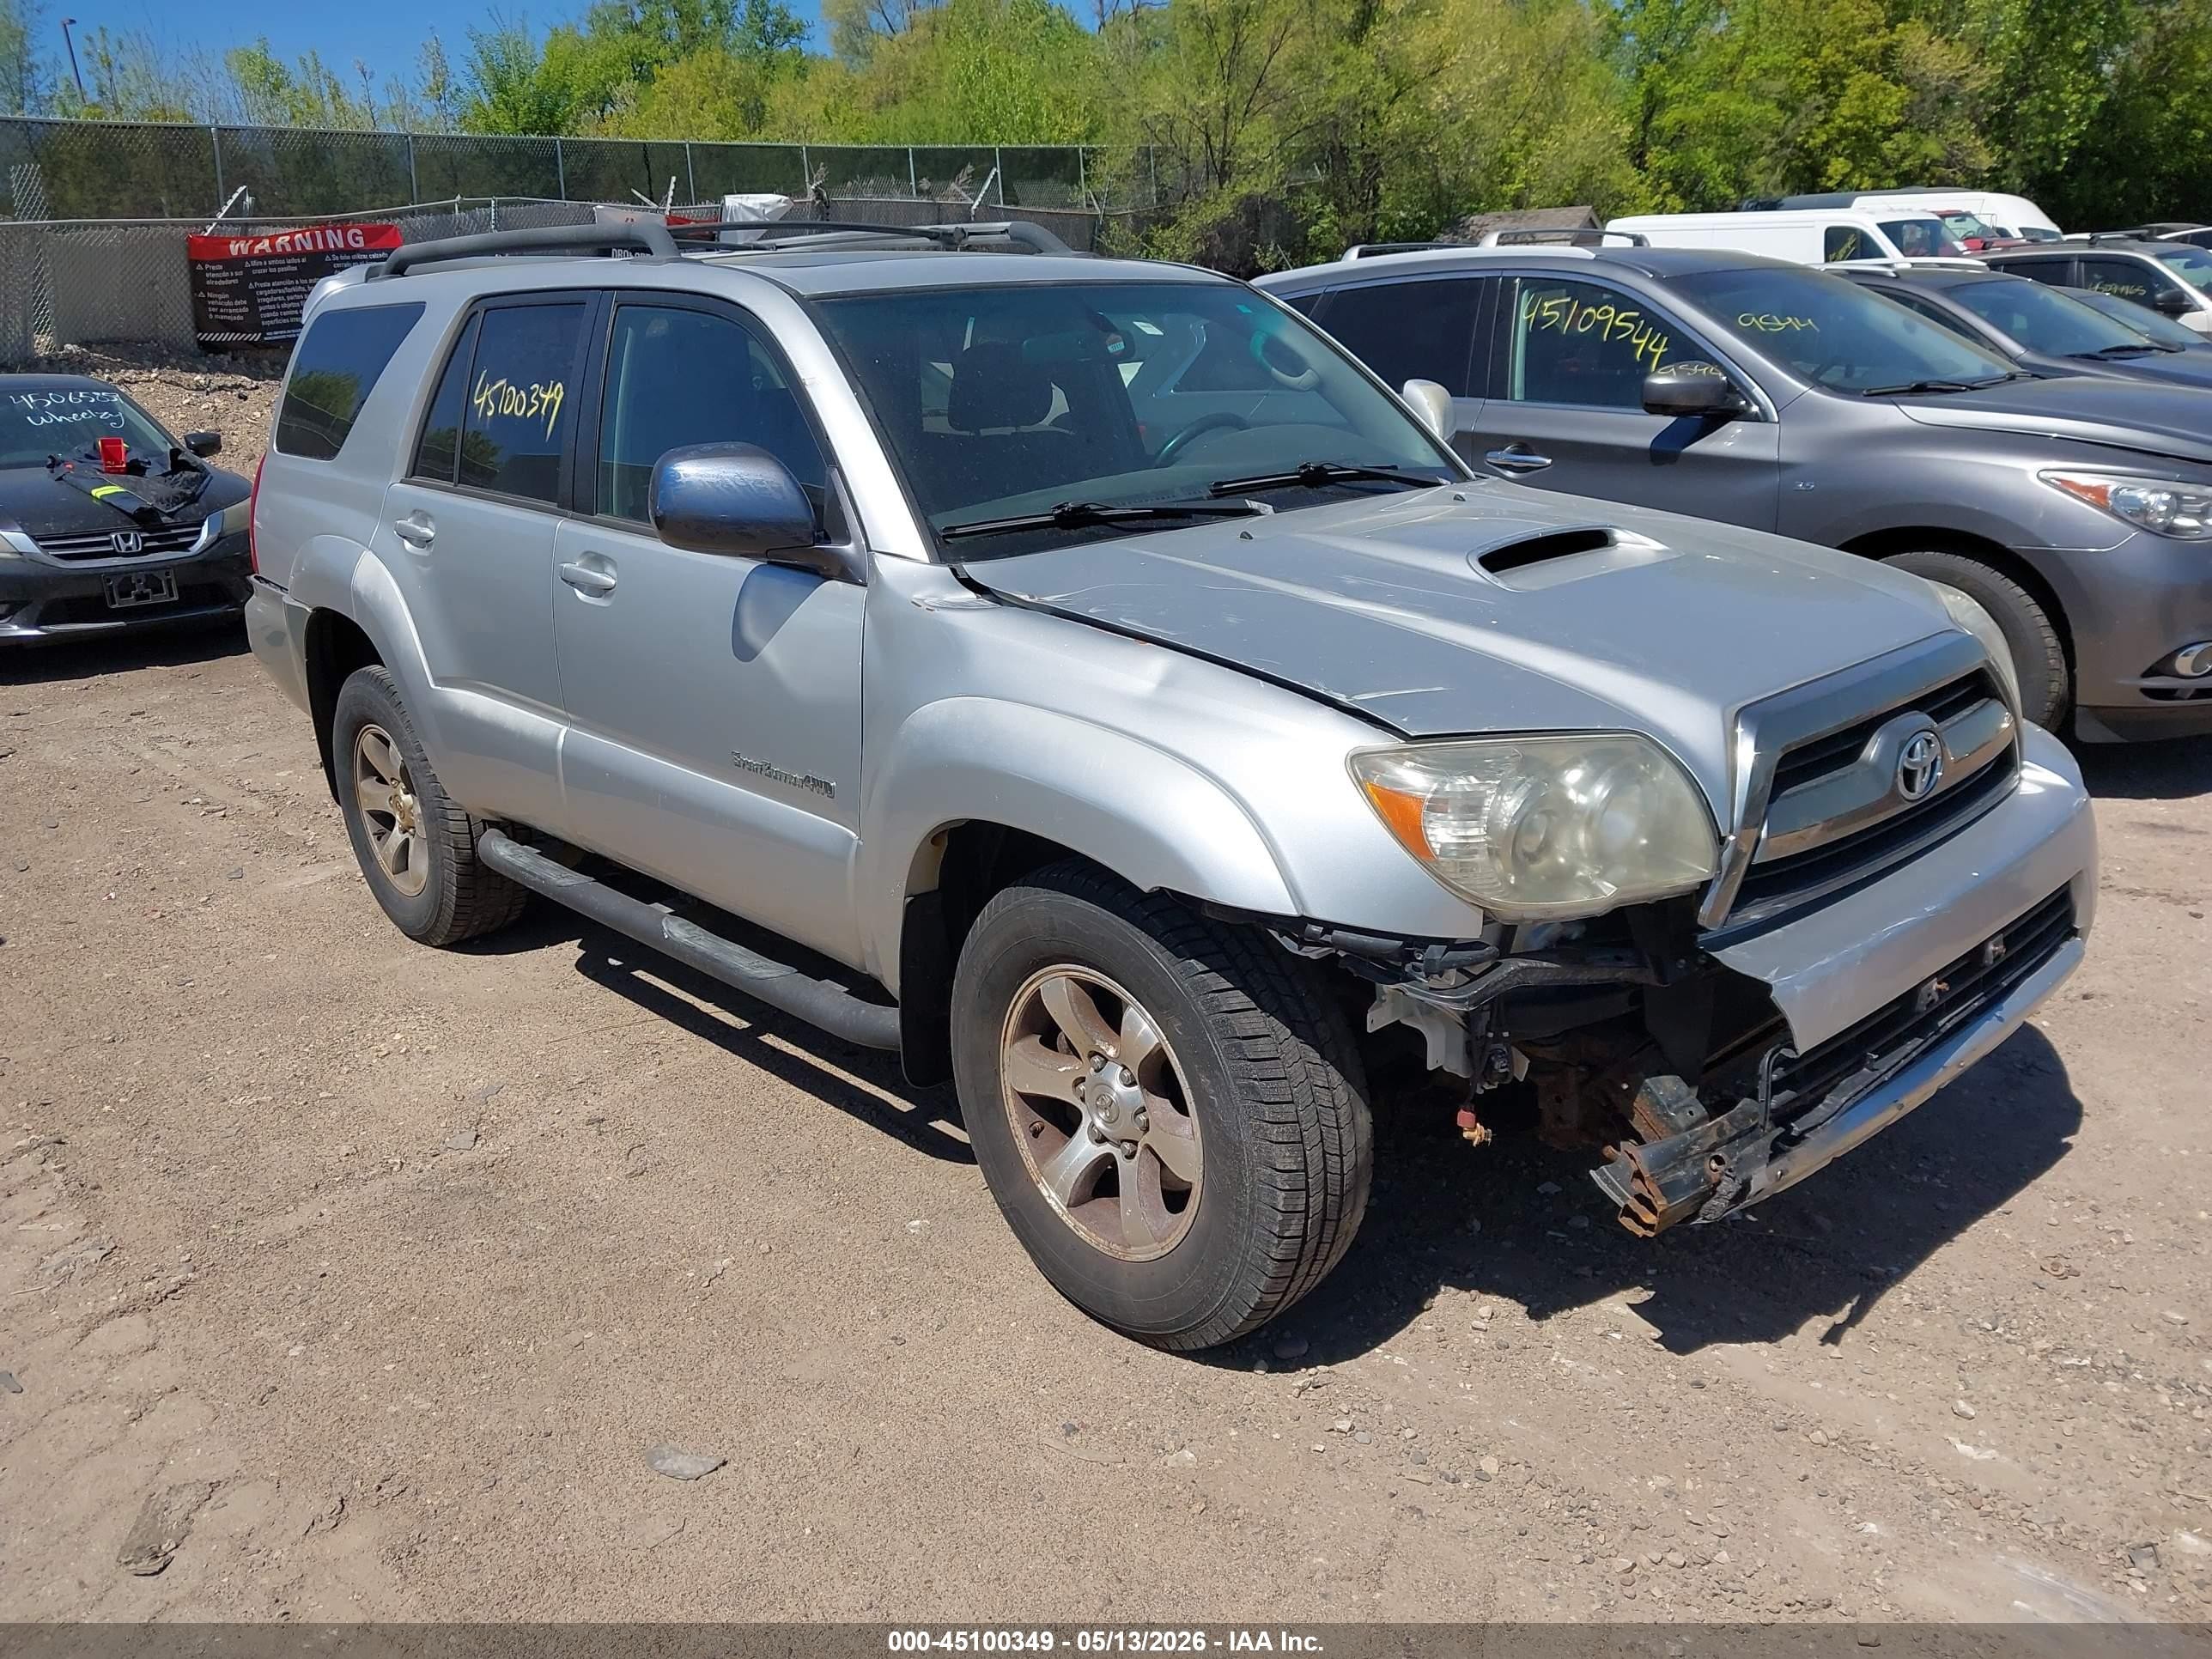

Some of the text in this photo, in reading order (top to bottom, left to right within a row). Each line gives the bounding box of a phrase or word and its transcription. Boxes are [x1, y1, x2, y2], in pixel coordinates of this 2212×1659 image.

[229, 228, 365, 255] WARNING
[1523, 293, 1668, 373] 45109544
[473, 368, 564, 442] 45100349
